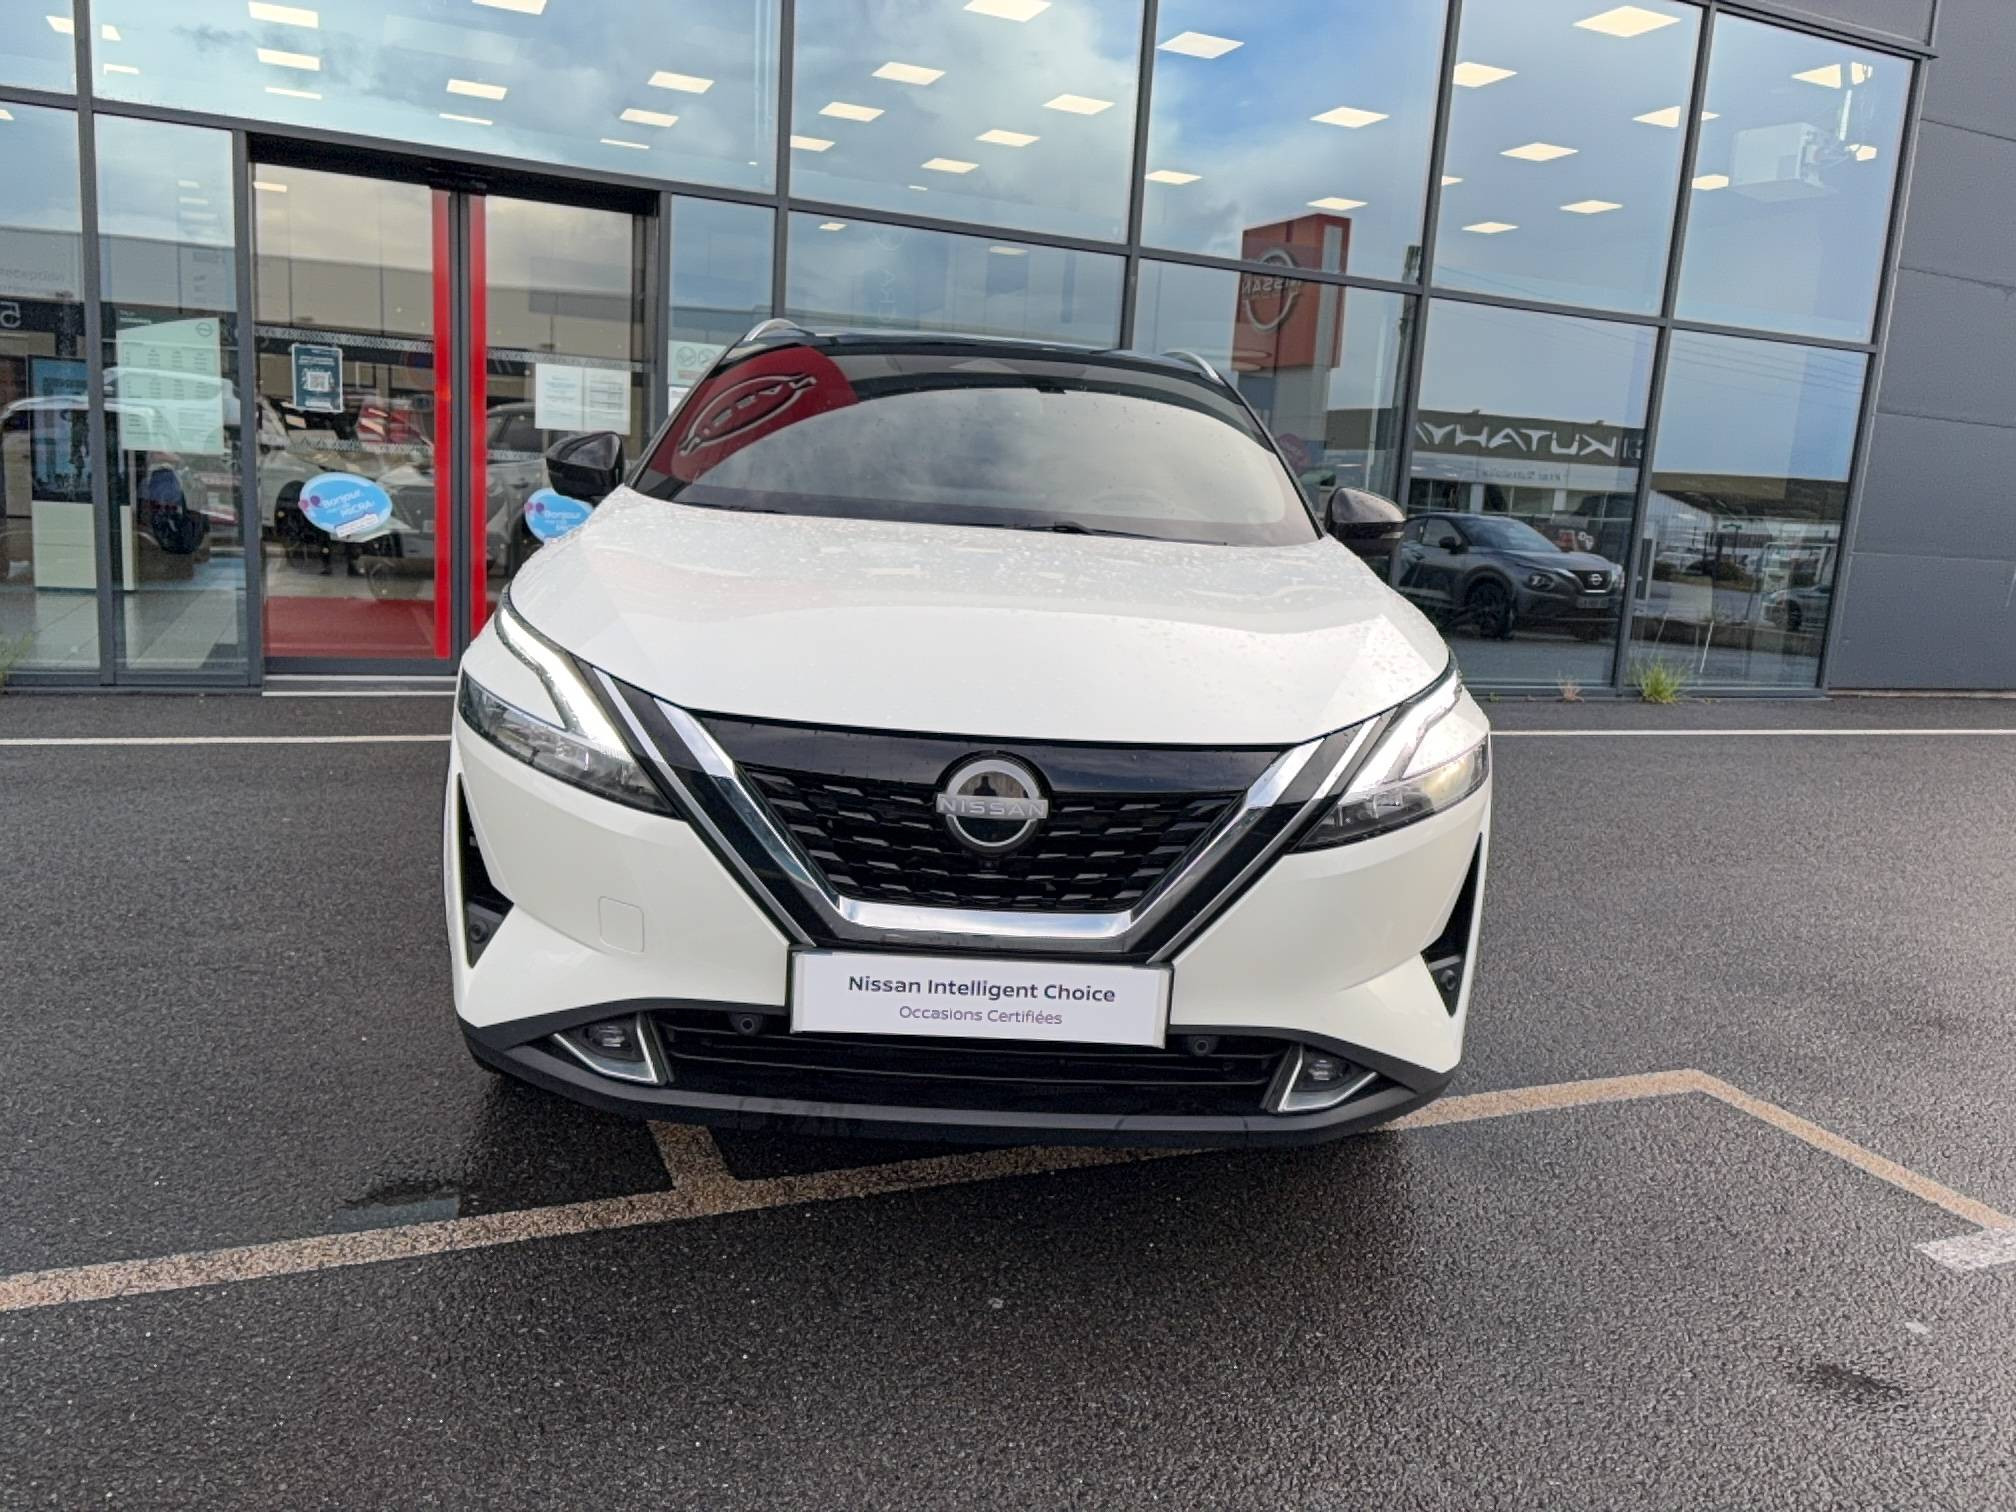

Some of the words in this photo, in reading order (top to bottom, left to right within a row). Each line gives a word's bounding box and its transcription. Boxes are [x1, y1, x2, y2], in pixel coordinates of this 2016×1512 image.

[940, 799, 1044, 816] NISSAN
[848, 976, 920, 993] Nissan
[928, 979, 1038, 1000] Intelligent
[1044, 984, 1115, 1002] Choice
[899, 1005, 983, 1021] Occasions
[987, 1009, 1062, 1024] Certifiées
